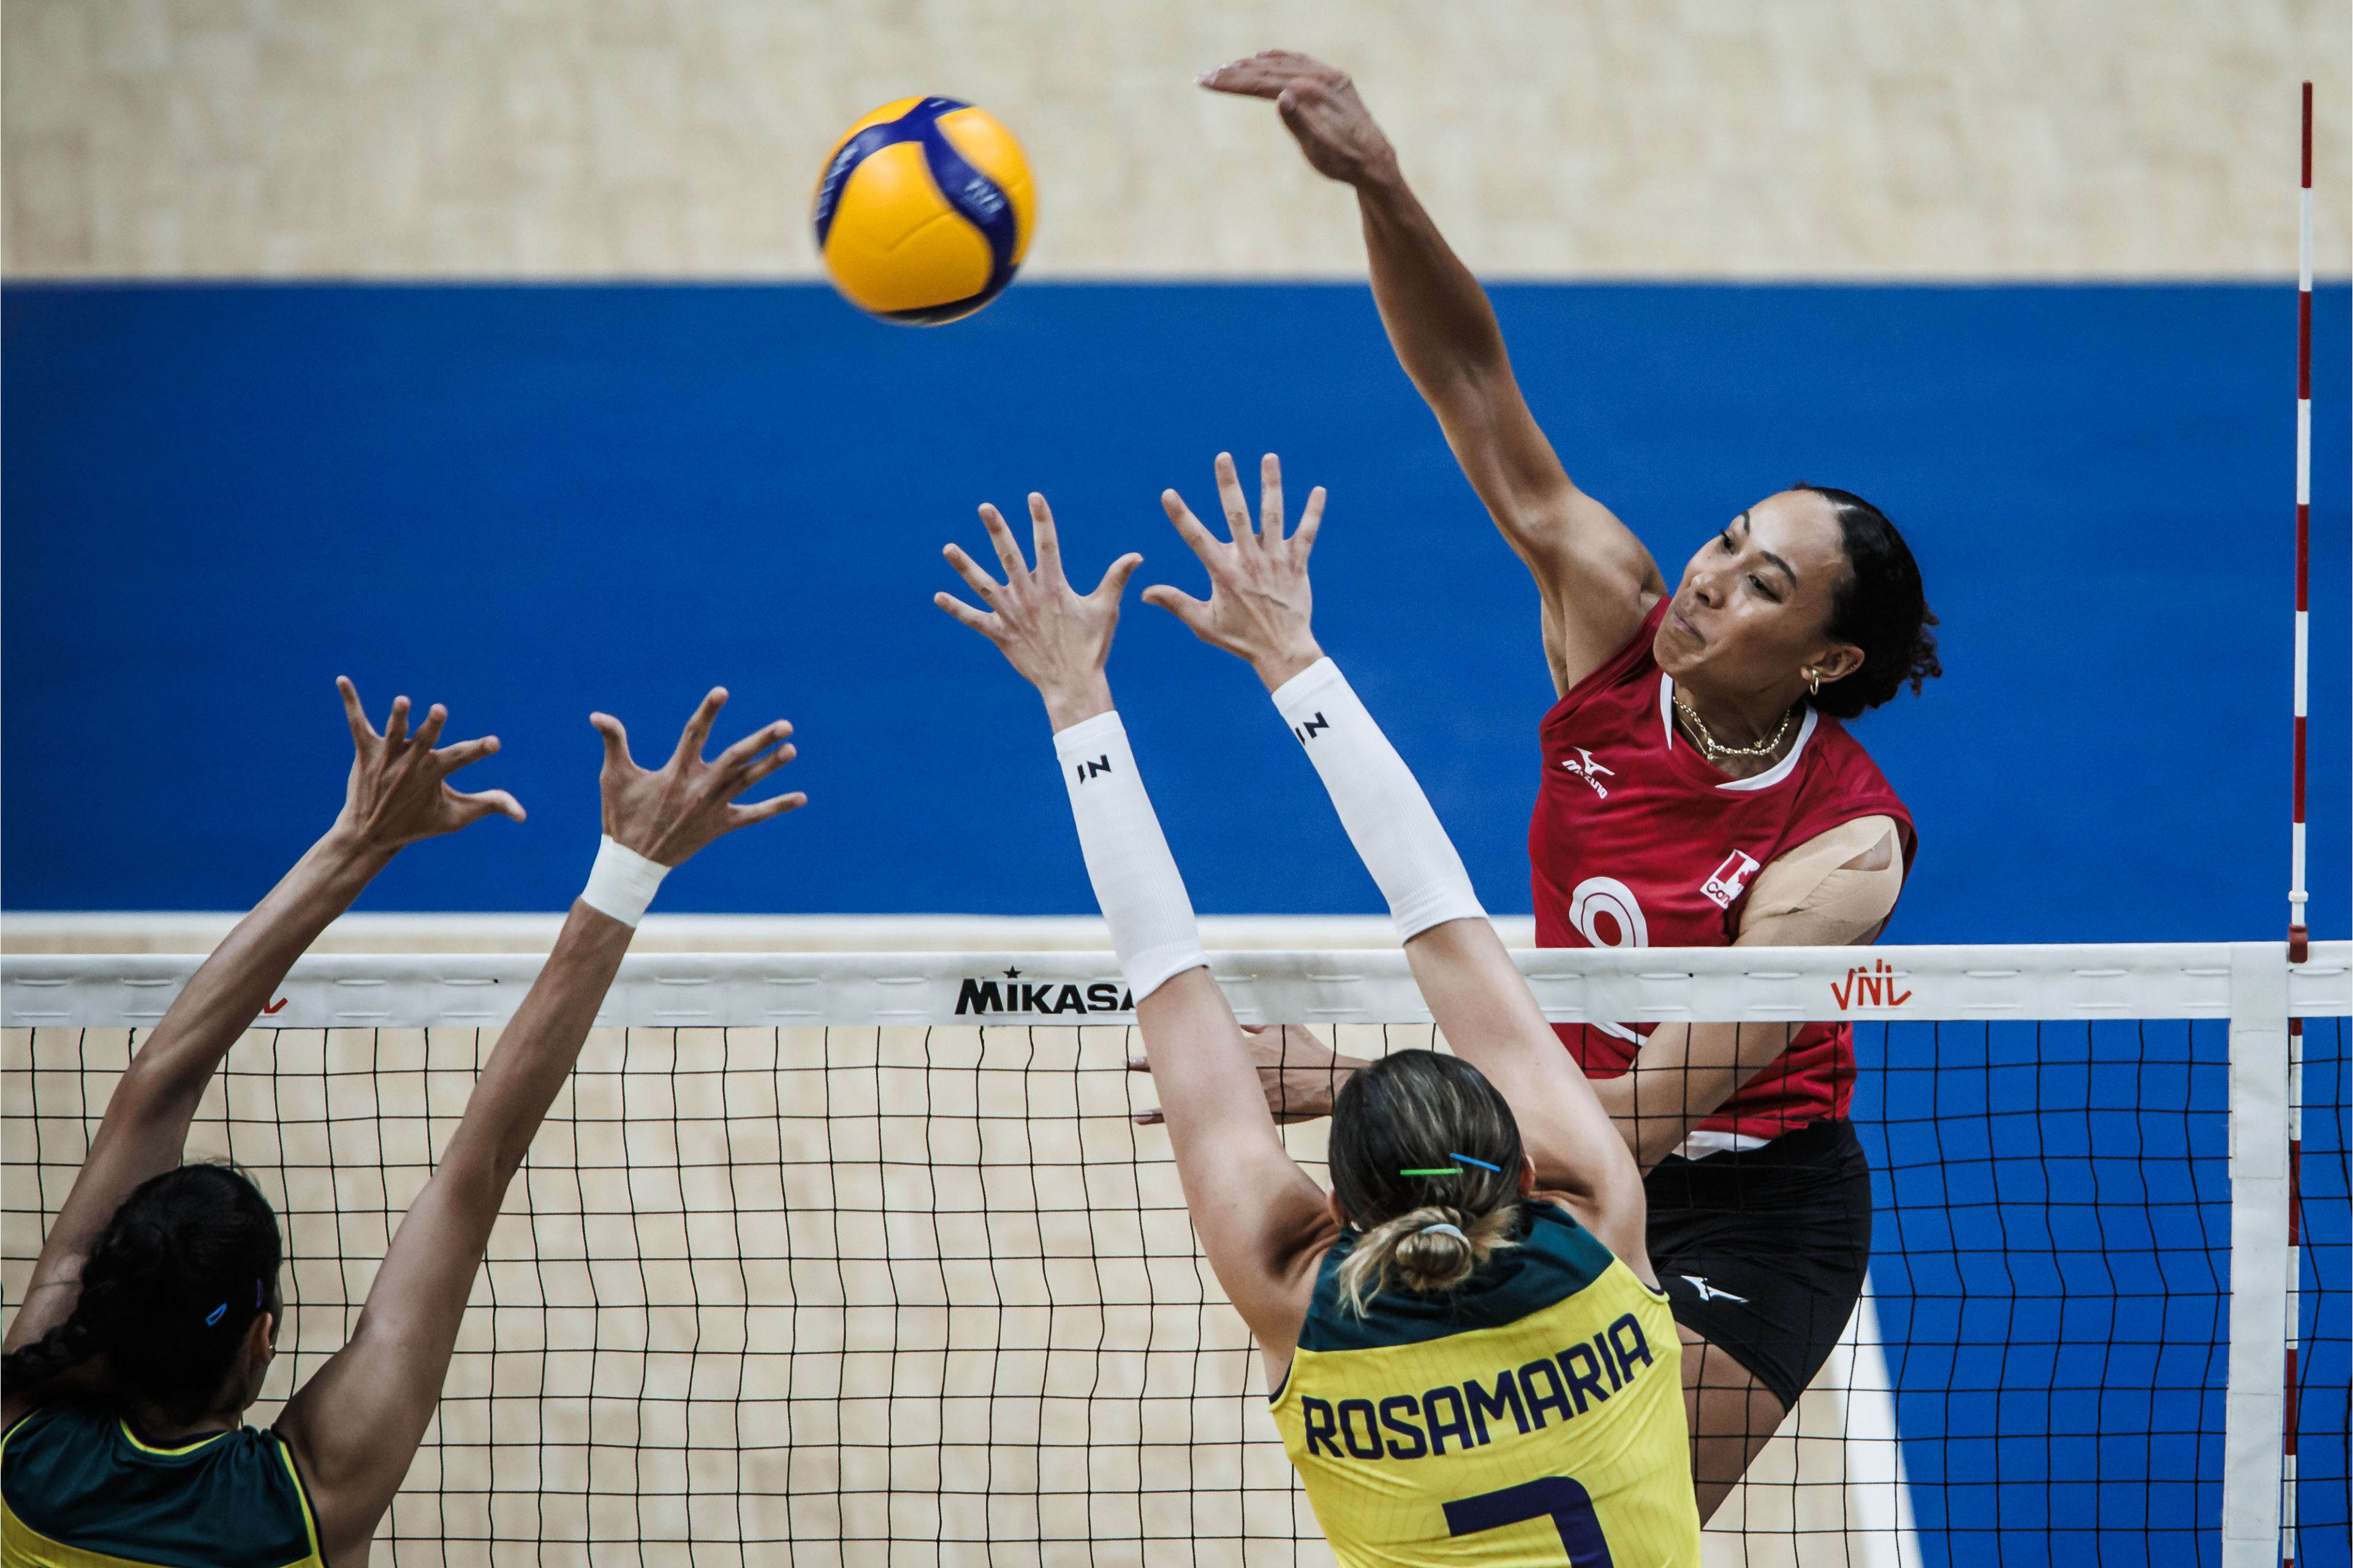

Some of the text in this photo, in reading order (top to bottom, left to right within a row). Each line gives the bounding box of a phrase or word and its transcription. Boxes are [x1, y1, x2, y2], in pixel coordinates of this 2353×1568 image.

[1707, 882, 1730, 904] Can
[1830, 959, 1912, 1010] VNL
[1301, 1313, 1654, 1460] ROSAMARIA
